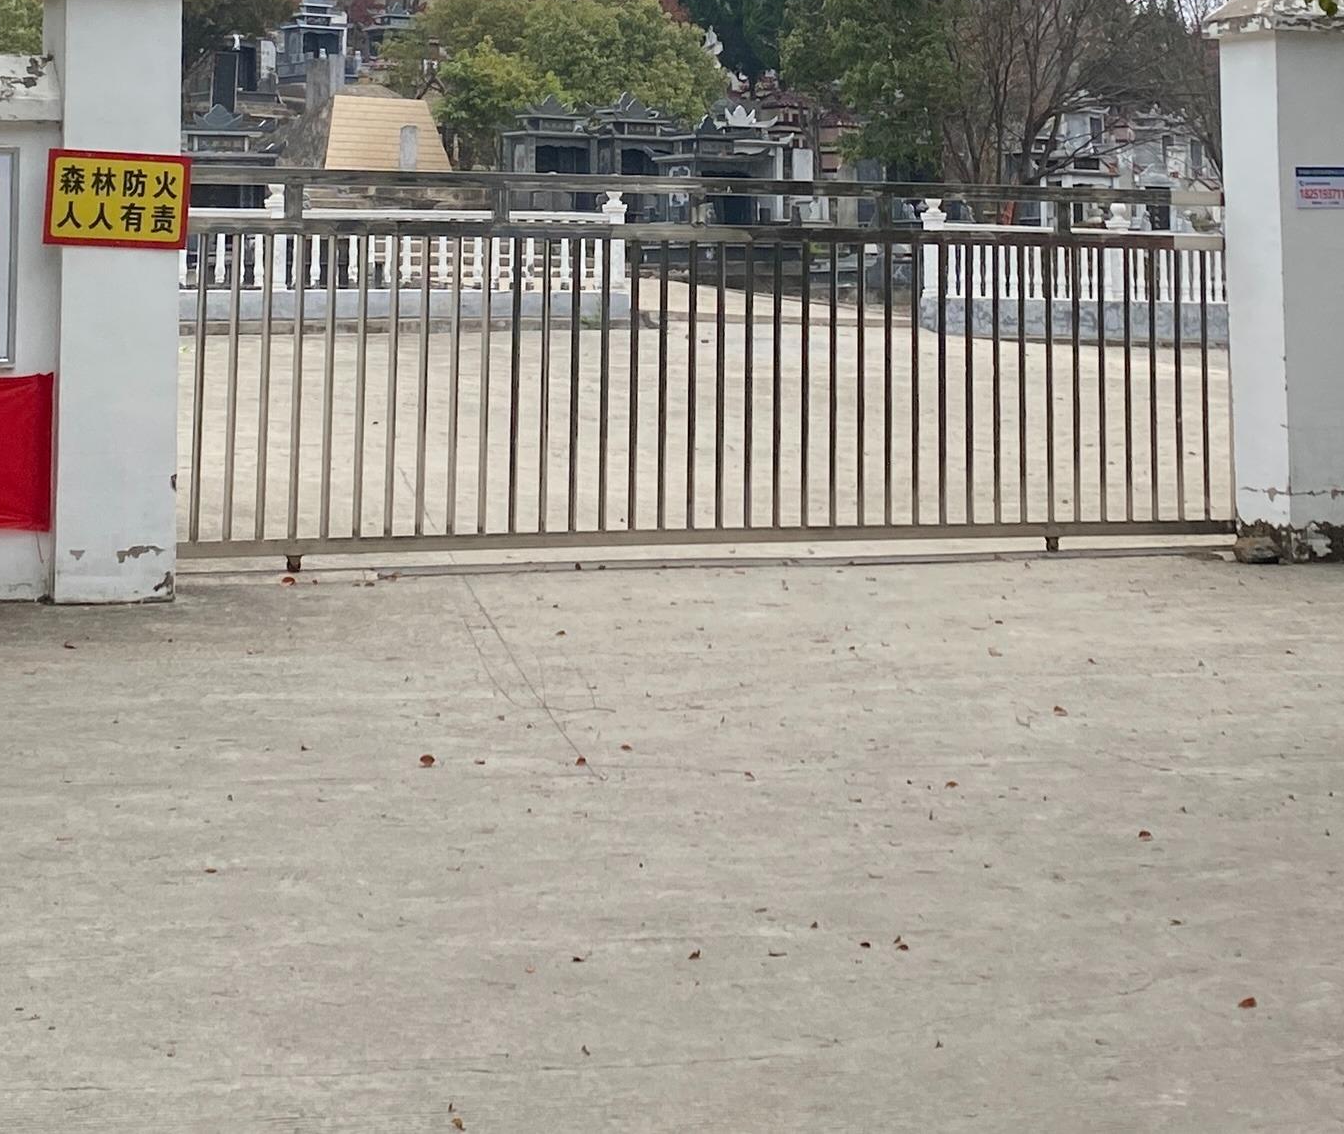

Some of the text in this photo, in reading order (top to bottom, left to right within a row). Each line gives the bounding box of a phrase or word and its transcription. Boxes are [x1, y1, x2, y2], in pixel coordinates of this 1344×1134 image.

[59, 165, 177, 199] 森林防火
[57, 201, 176, 234] 人人有责
